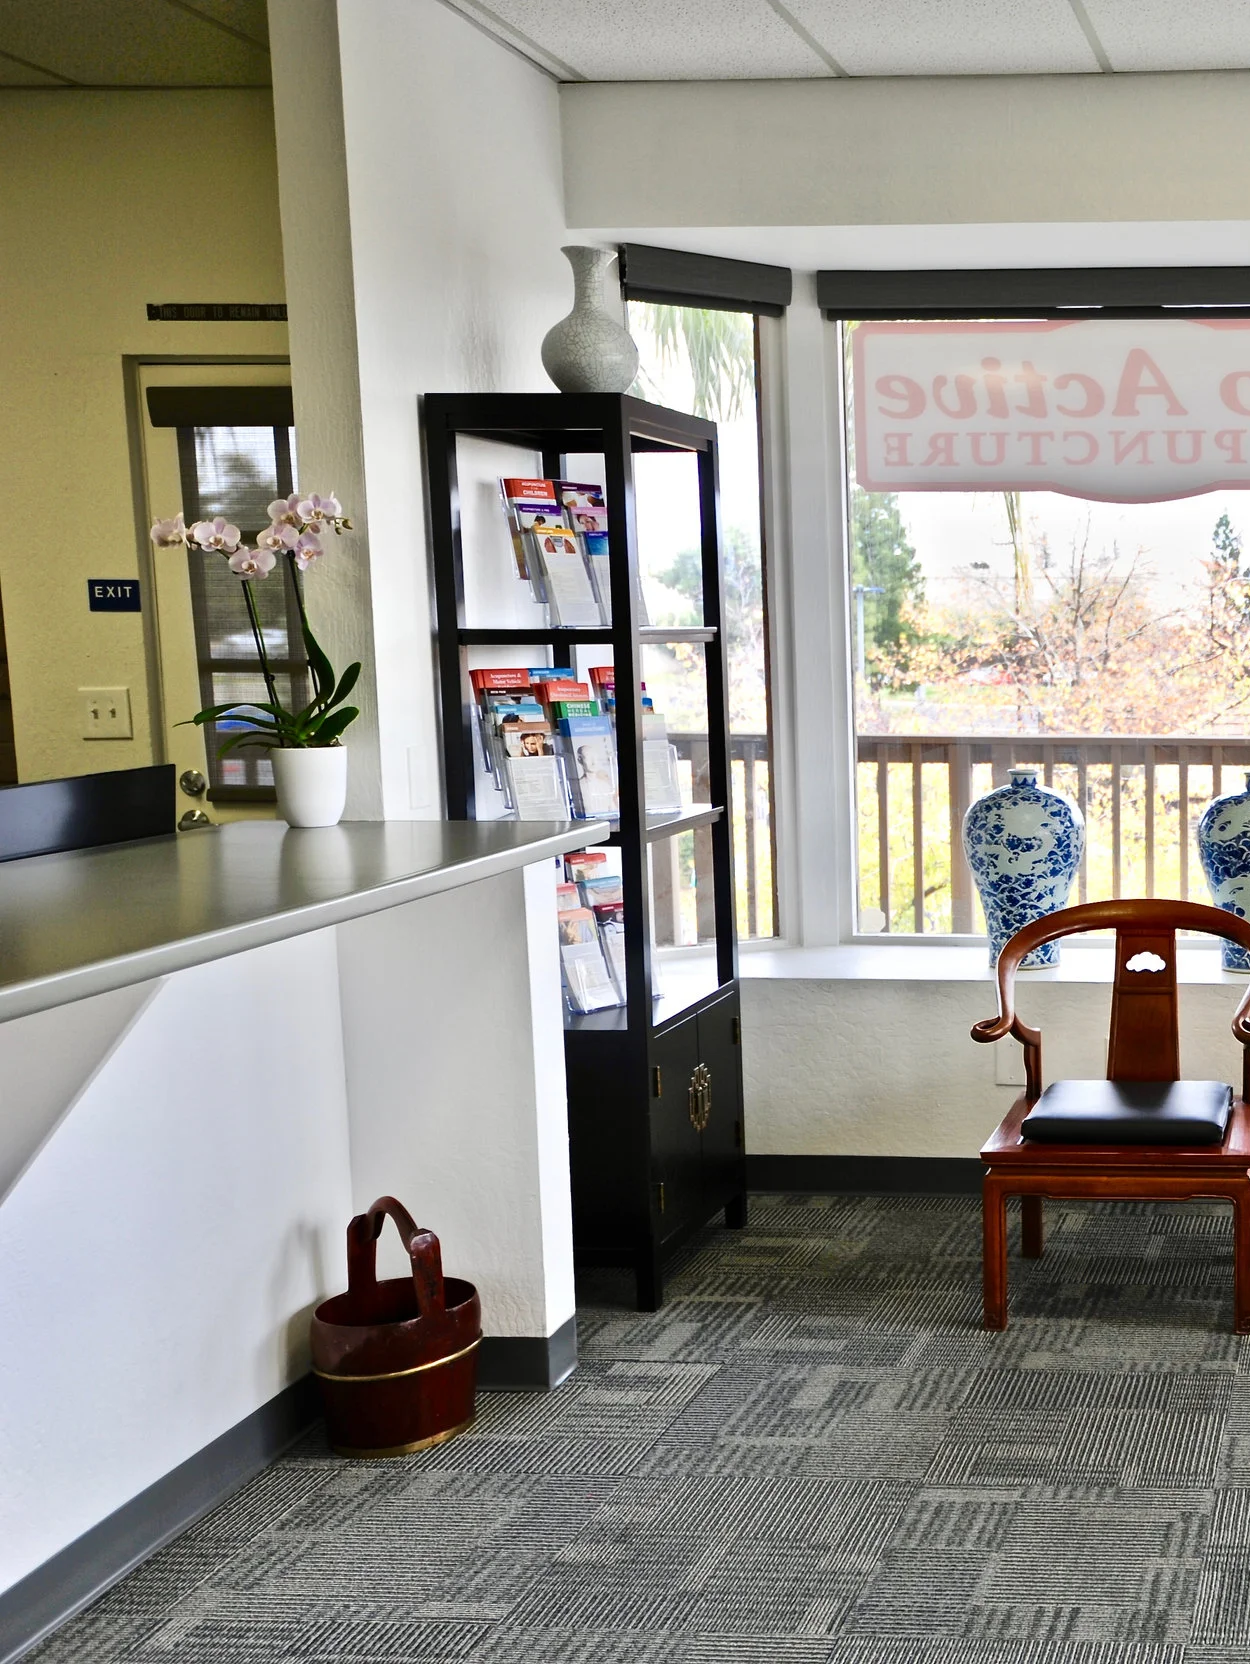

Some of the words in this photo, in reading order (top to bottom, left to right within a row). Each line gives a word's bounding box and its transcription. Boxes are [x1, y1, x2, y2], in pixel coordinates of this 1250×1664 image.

[183, 306, 206, 318] DOOR
[212, 306, 223, 318] TO
[229, 306, 260, 318] REMAIN
[94, 586, 133, 598] EXIT
